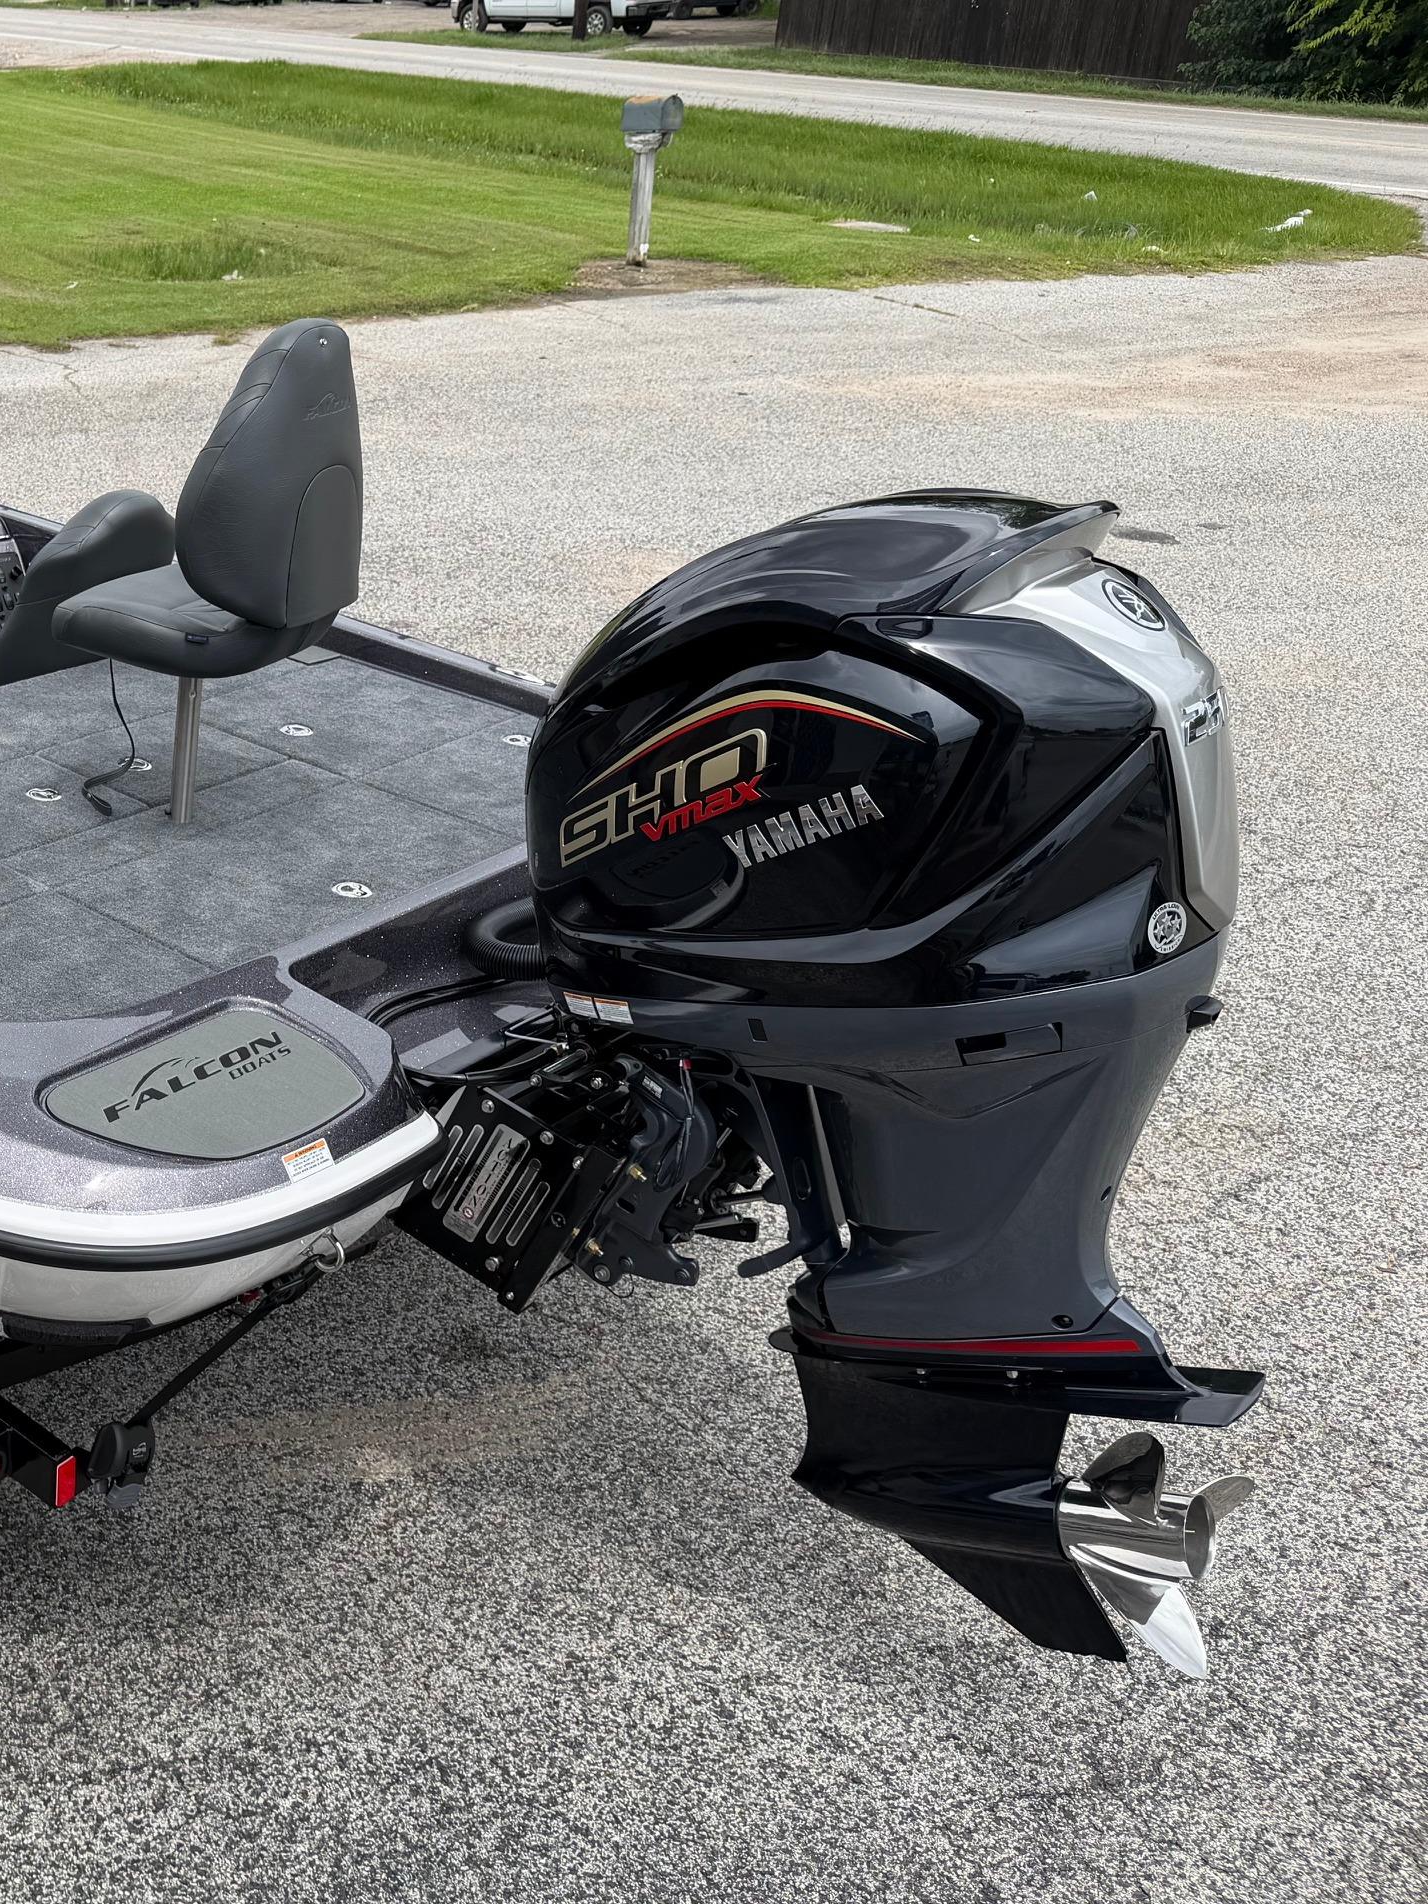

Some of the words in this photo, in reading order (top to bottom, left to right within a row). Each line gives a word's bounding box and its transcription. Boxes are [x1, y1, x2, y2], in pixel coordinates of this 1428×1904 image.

[559, 727, 768, 869] SHO
[722, 783, 885, 869] YAMAHA
[103, 1031, 284, 1124] FALCON
[228, 1046, 292, 1081] BOATS
